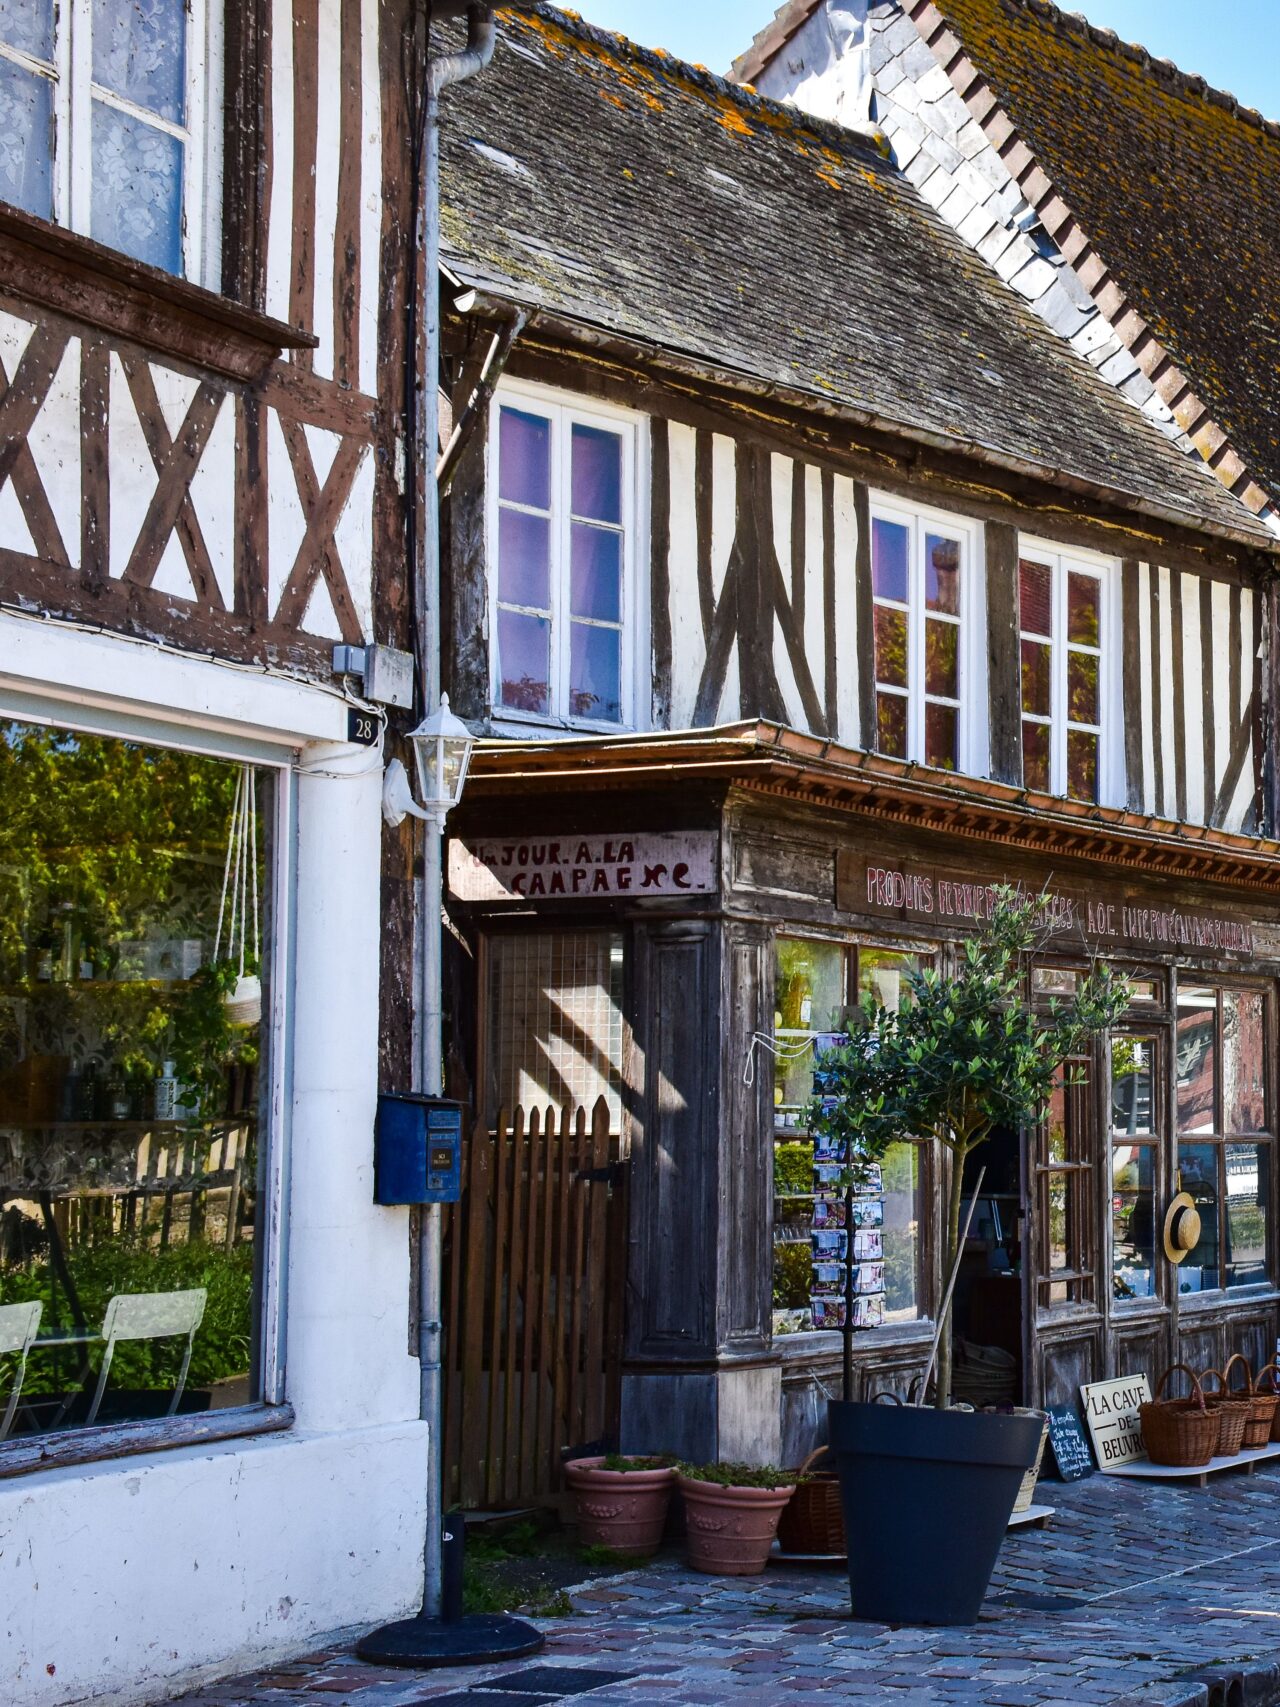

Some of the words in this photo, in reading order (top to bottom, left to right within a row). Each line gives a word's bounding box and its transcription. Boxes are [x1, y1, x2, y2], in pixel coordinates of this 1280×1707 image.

[356, 718, 372, 739] 28
[938, 880, 1000, 921] FERMIER
[1092, 1395, 1111, 1416] LA
[1112, 1386, 1145, 1411] CAVE
[1118, 1415, 1134, 1431] DE
